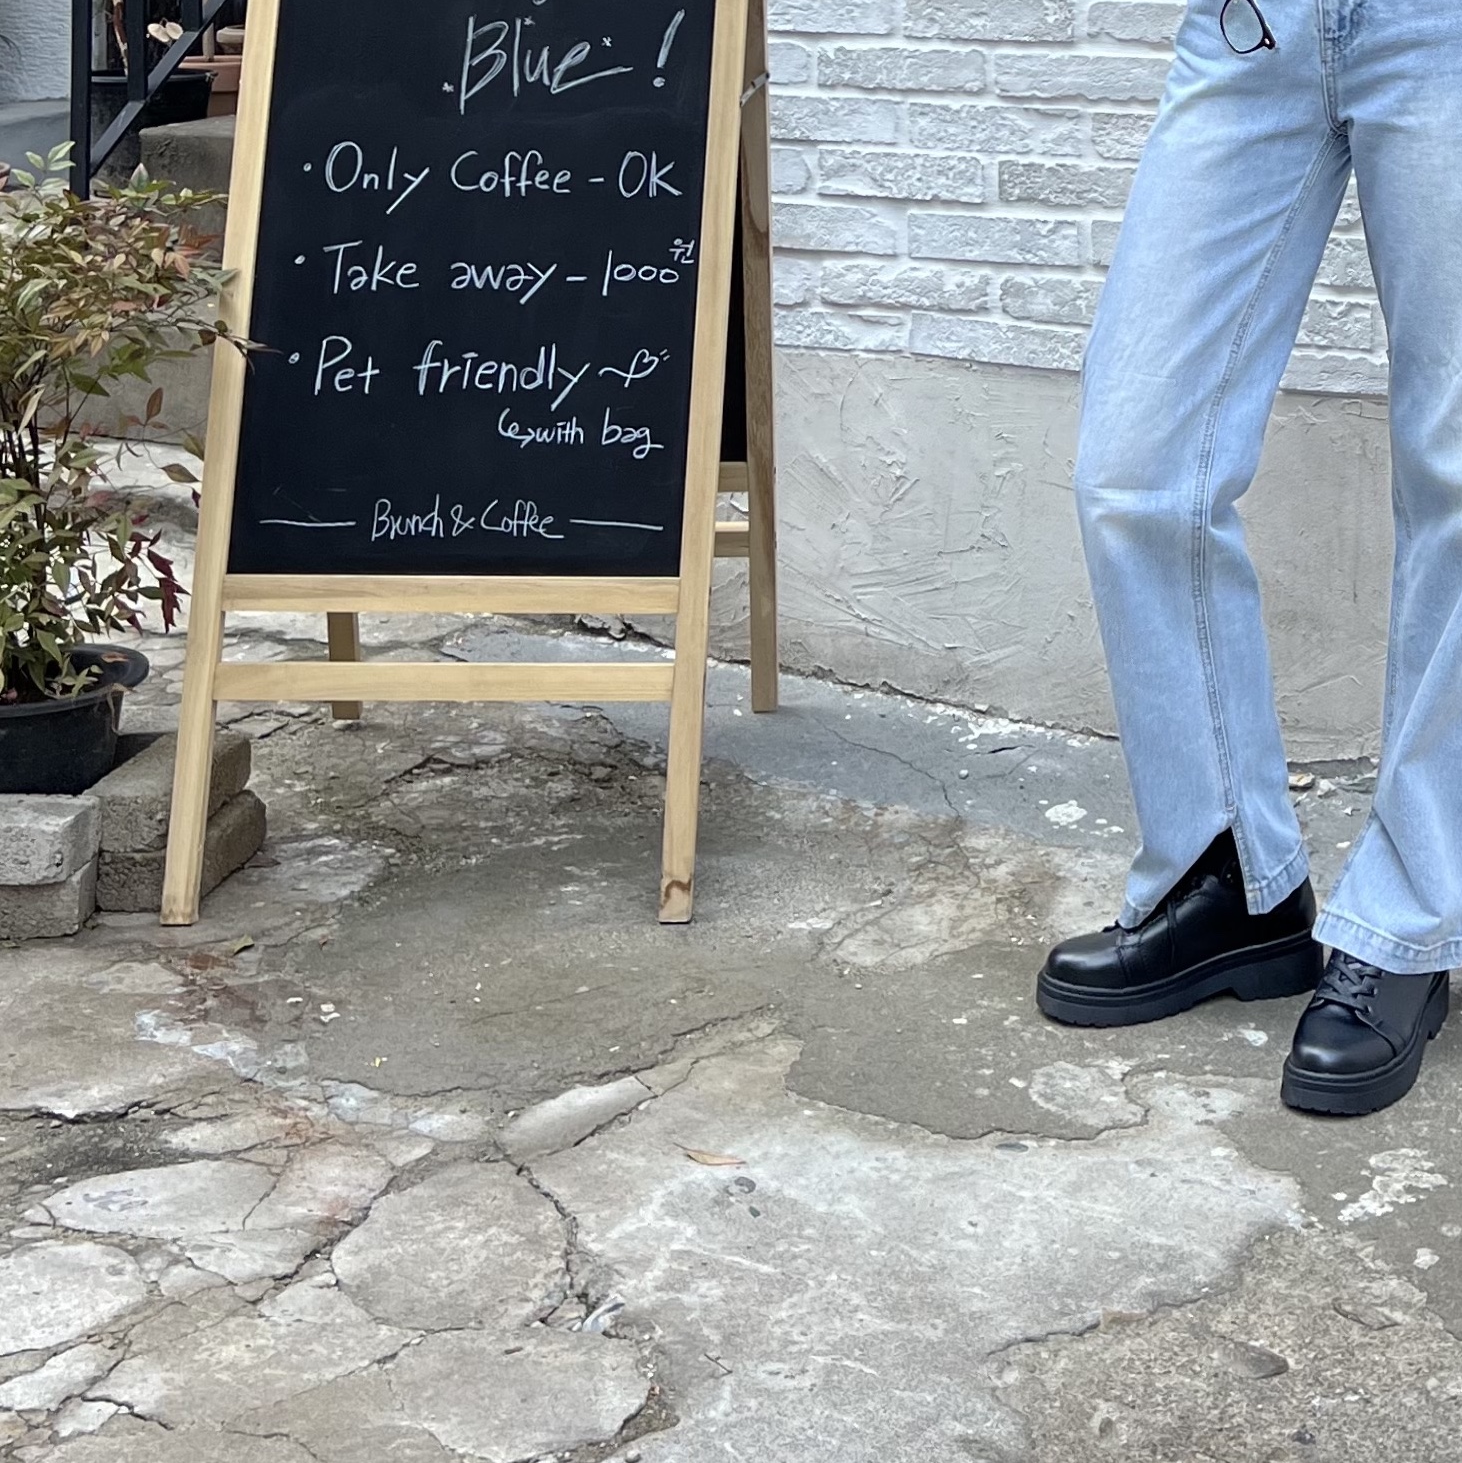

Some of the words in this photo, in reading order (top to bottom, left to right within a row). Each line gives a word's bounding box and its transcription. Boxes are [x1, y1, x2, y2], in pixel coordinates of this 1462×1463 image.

[325, 141, 430, 215] Only
[450, 149, 571, 198] Coffee
[618, 150, 683, 198] OK
[323, 240, 420, 295] Take
[450, 261, 558, 305] away
[314, 335, 380, 395] Pet
[413, 340, 591, 411] friendly
[534, 416, 584, 446] with
[601, 407, 664, 459] bag
